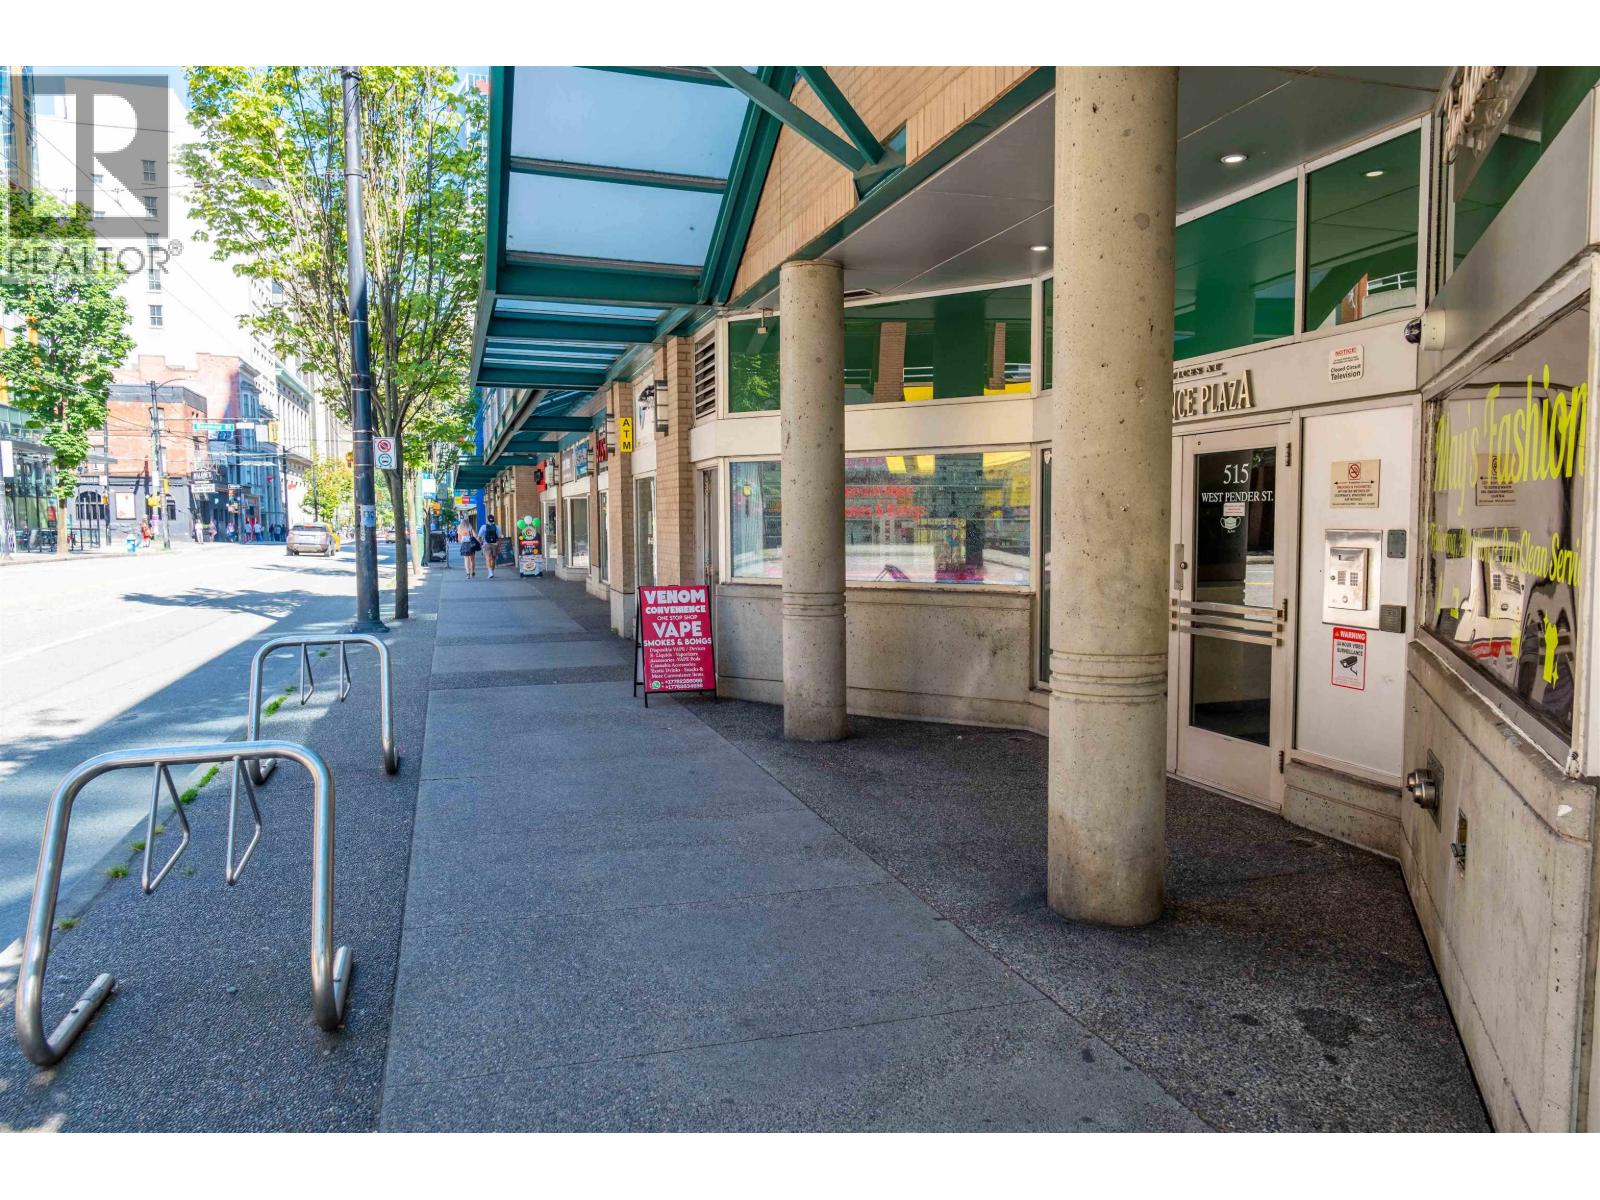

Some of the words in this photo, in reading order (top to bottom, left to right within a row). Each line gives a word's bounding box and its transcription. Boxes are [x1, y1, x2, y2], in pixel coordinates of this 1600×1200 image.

[1330, 370, 1360, 380] Television
[1200, 370, 1253, 414] PLAZA
[622, 418, 631, 450] ATM
[1483, 364, 1588, 486] Fashion
[1224, 463, 1250, 484] 515
[1202, 492, 1224, 502] WEST
[1225, 491, 1260, 502] PENDER
[1262, 490, 1274, 502] ST.
[1520, 530, 1548, 578] Clean
[644, 589, 706, 604] VENOM
[646, 605, 706, 614] CONVENIENCE
[652, 620, 702, 638] VAPE
[1340, 630, 1366, 640] WARNING
